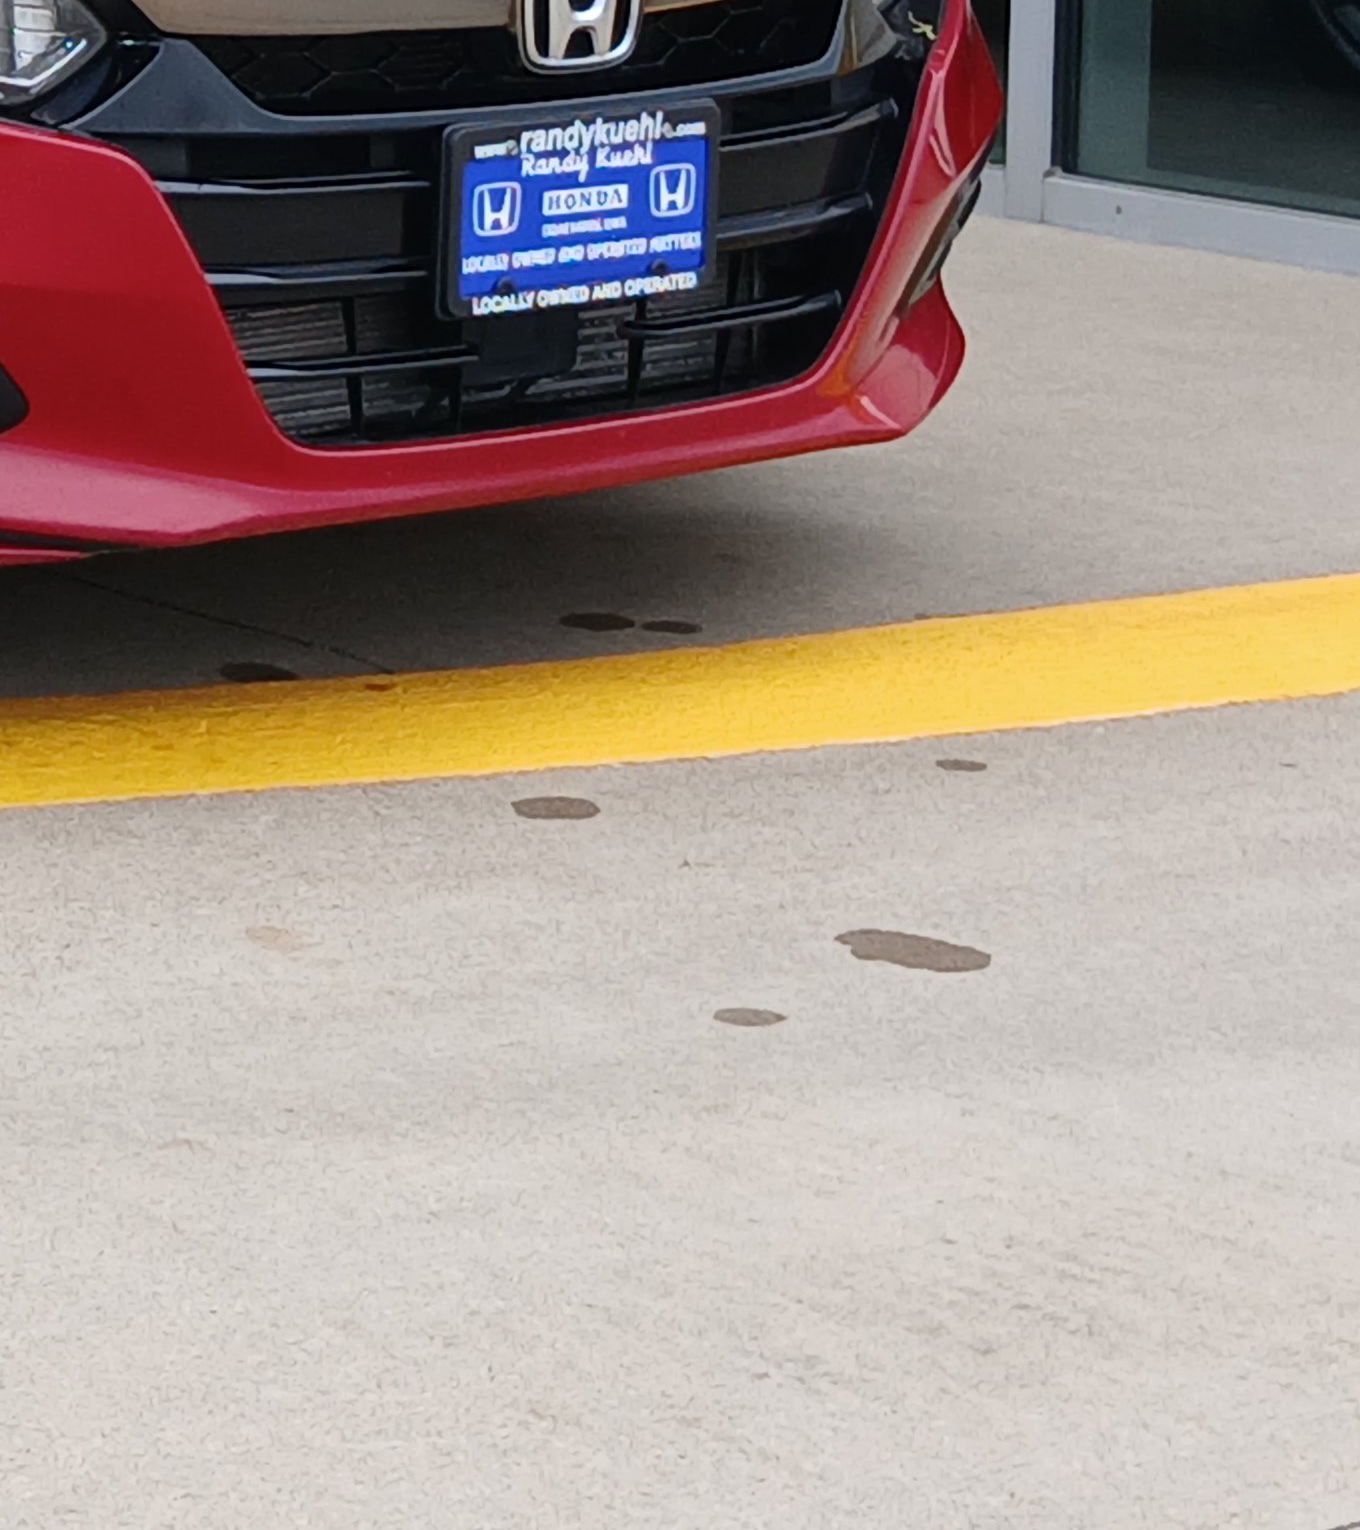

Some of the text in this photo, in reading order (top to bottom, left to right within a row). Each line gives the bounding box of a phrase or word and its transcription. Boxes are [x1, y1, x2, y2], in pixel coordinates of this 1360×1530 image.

[521, 142, 653, 182] Randy Kuehl
[547, 188, 624, 211] HONDA
[472, 272, 697, 315] LOCALLY OWNED AND OPERATED
